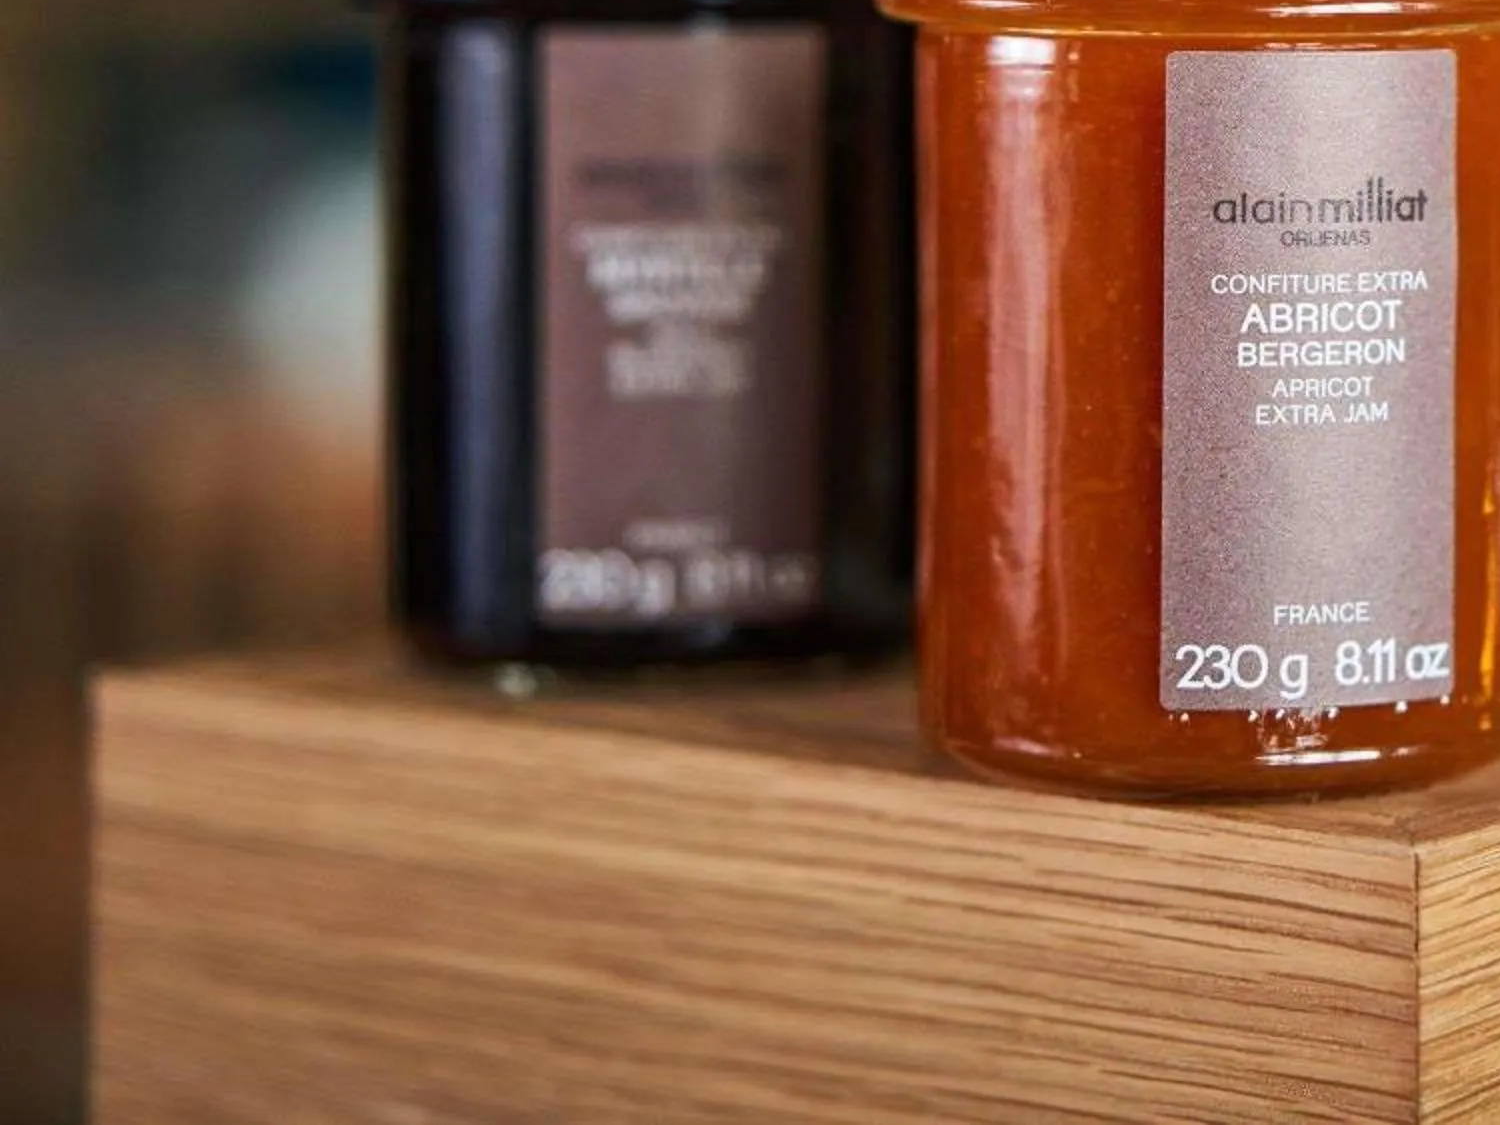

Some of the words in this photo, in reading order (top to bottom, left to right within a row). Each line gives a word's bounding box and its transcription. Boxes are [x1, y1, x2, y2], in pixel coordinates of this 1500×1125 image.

[1210, 274, 1350, 295] CONFITURE
[1357, 271, 1428, 292] EXTRA
[1239, 299, 1402, 334] ABRICOT
[1236, 338, 1406, 367] BERGERON
[1272, 376, 1374, 398] APRICOT
[1256, 404, 1336, 425] EXTRA
[1344, 402, 1389, 423] JAM
[1273, 601, 1370, 625] FRANCE
[1176, 643, 1269, 690] 230
[1279, 654, 1310, 700] g
[1335, 637, 1397, 687] 8.11
[1406, 643, 1450, 680] oz
